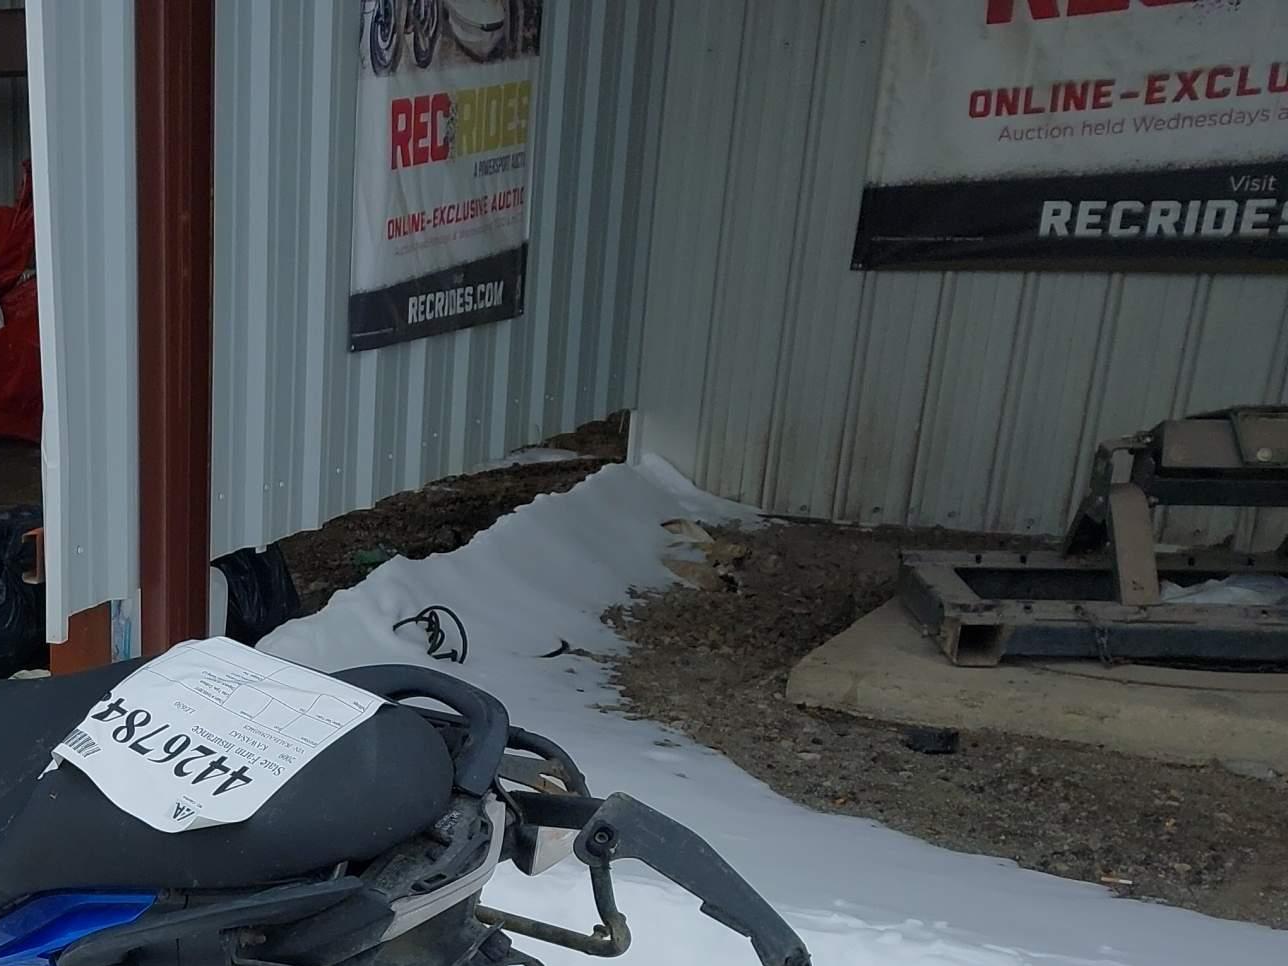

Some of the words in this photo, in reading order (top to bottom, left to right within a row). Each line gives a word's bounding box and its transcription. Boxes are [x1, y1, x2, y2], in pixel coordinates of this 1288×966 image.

[969, 62, 1288, 119] ONLINE-EXCLU
[998, 123, 1074, 142] Auction
[1081, 116, 1124, 137] held
[1133, 106, 1271, 135] Wednesdays
[1230, 174, 1277, 193] Visit
[387, 195, 488, 240] ONLINE-EXCLUSIVE
[408, 280, 504, 324] RECRIDES.COM
[191, 725, 235, 753] Insurance
[229, 730, 268, 751] KAWASAKI
[234, 745, 260, 764] Farm
[260, 759, 286, 776] State
